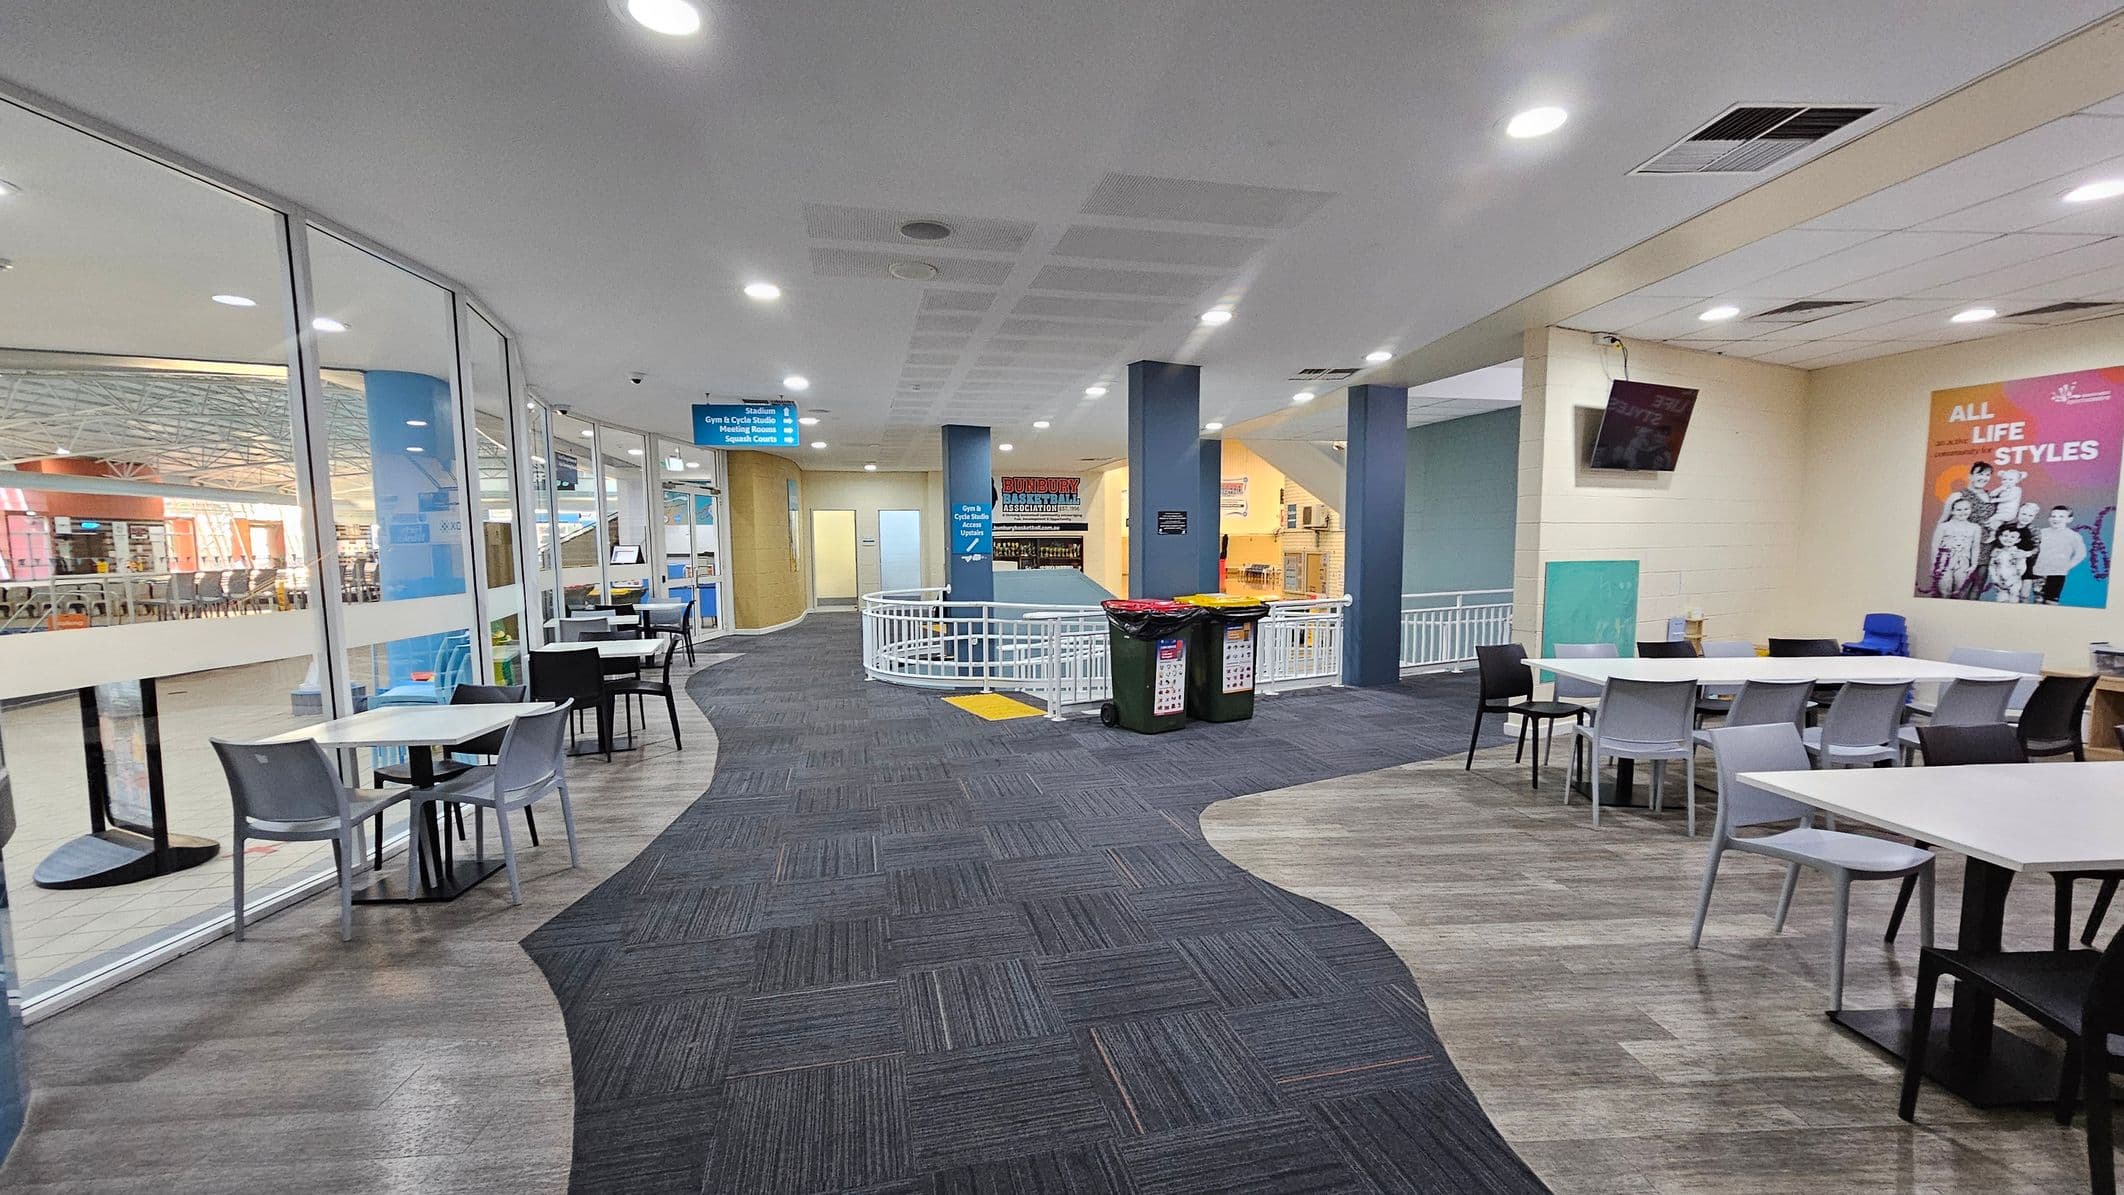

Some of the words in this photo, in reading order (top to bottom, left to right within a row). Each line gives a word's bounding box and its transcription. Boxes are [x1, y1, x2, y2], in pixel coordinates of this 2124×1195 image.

[745, 407, 776, 415] Stadium
[1948, 401, 1996, 423] ALL
[705, 416, 723, 424] Gym
[731, 416, 751, 425] Cycle
[752, 416, 777, 424] Studio
[719, 425, 751, 434] Meeting
[751, 425, 777, 433] Rooms
[1971, 422, 2025, 444] LIFE
[725, 435, 752, 443] Squash
[752, 435, 778, 443] Courts
[1994, 440, 2099, 466] STYLES
[1002, 477, 1080, 494] BUNBURY
[1002, 493, 1080, 505] BASKETBALL
[1003, 504, 1058, 512] ASSOCIATION
[954, 513, 970, 521] Cycle
[960, 529, 984, 537] Upstairs
